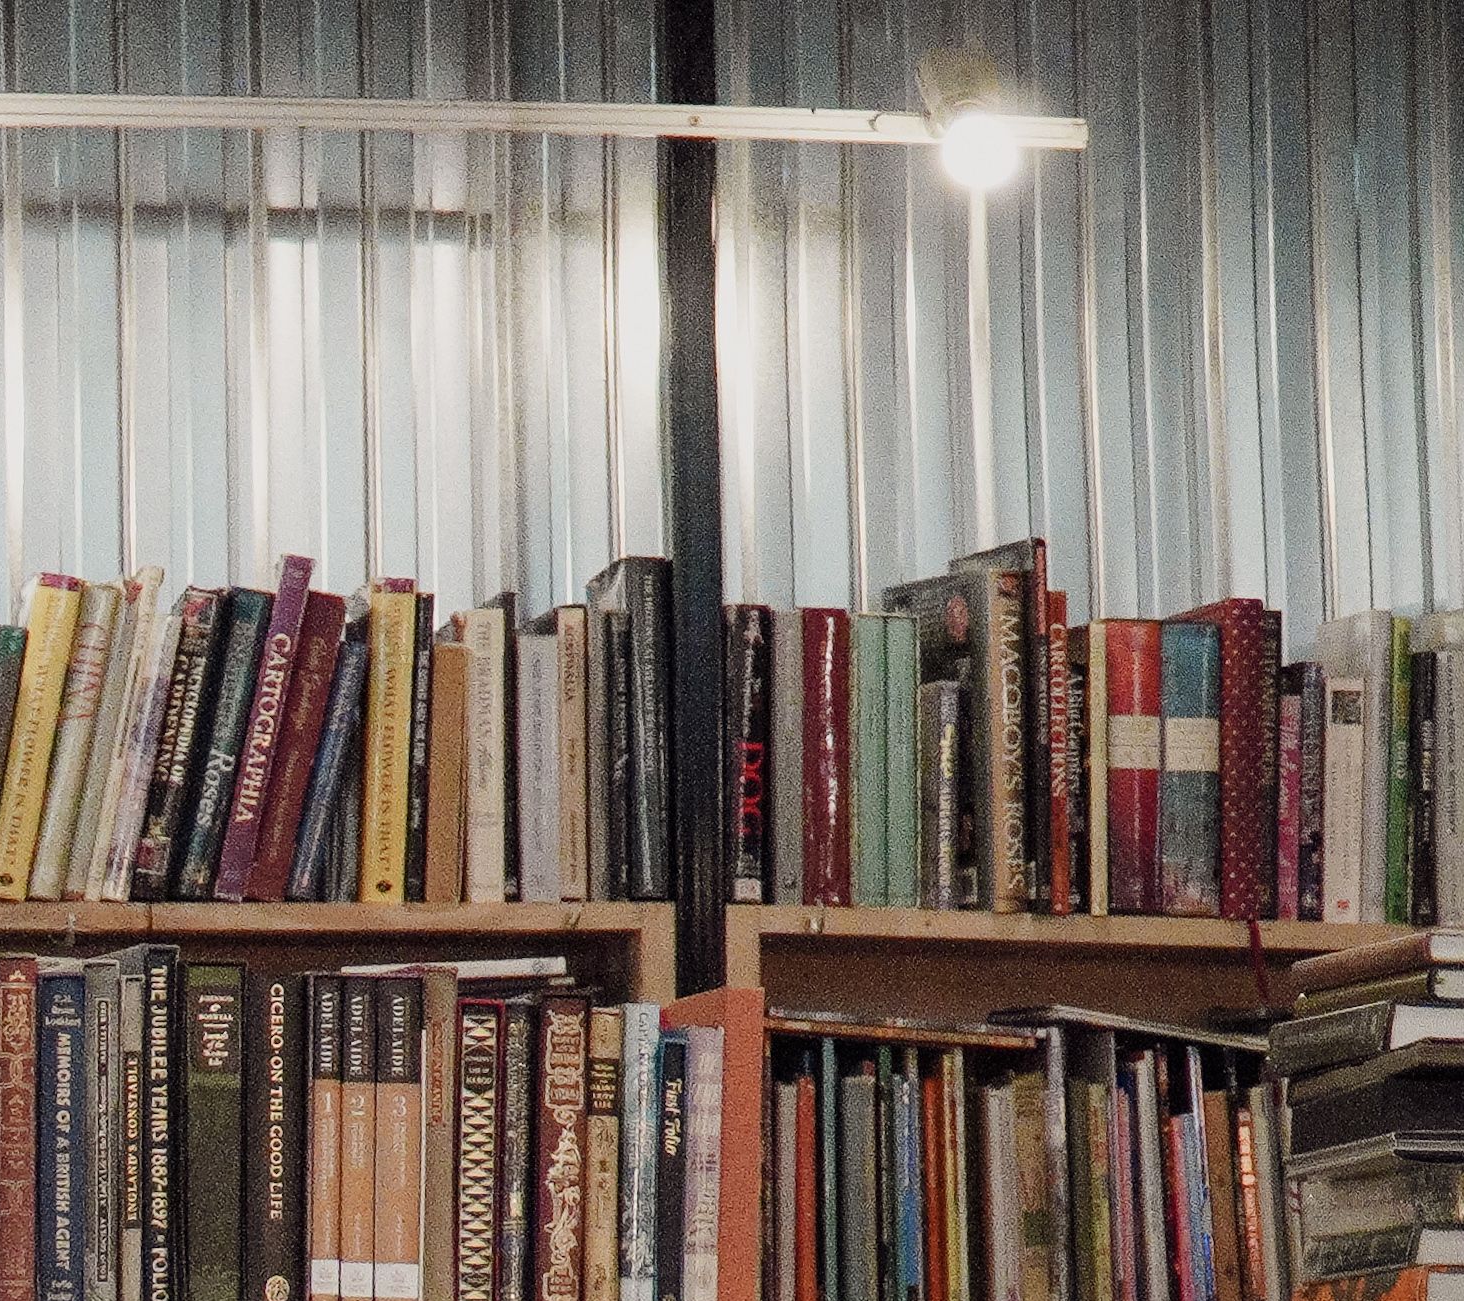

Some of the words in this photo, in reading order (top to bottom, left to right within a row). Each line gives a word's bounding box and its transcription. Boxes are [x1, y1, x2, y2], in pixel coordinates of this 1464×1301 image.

[234, 632, 290, 823] CARTOGRAPHIA
[193, 749, 236, 827] Roses
[269, 983, 285, 1051] CICERO
[318, 990, 335, 1073] ADELAIDE
[389, 994, 405, 1077] ADELAIDE
[55, 1033, 71, 1105] MEMOIRS
[269, 1057, 285, 1080] ON
[55, 1111, 71, 1131] OF
[269, 1085, 285, 1121] THE
[55, 1135, 71, 1147] A
[269, 1127, 285, 1174] GOOD
[54, 1152, 71, 1211] BRITISH
[269, 1179, 285, 1219] LIFE
[53, 1215, 71, 1271] AGENT
